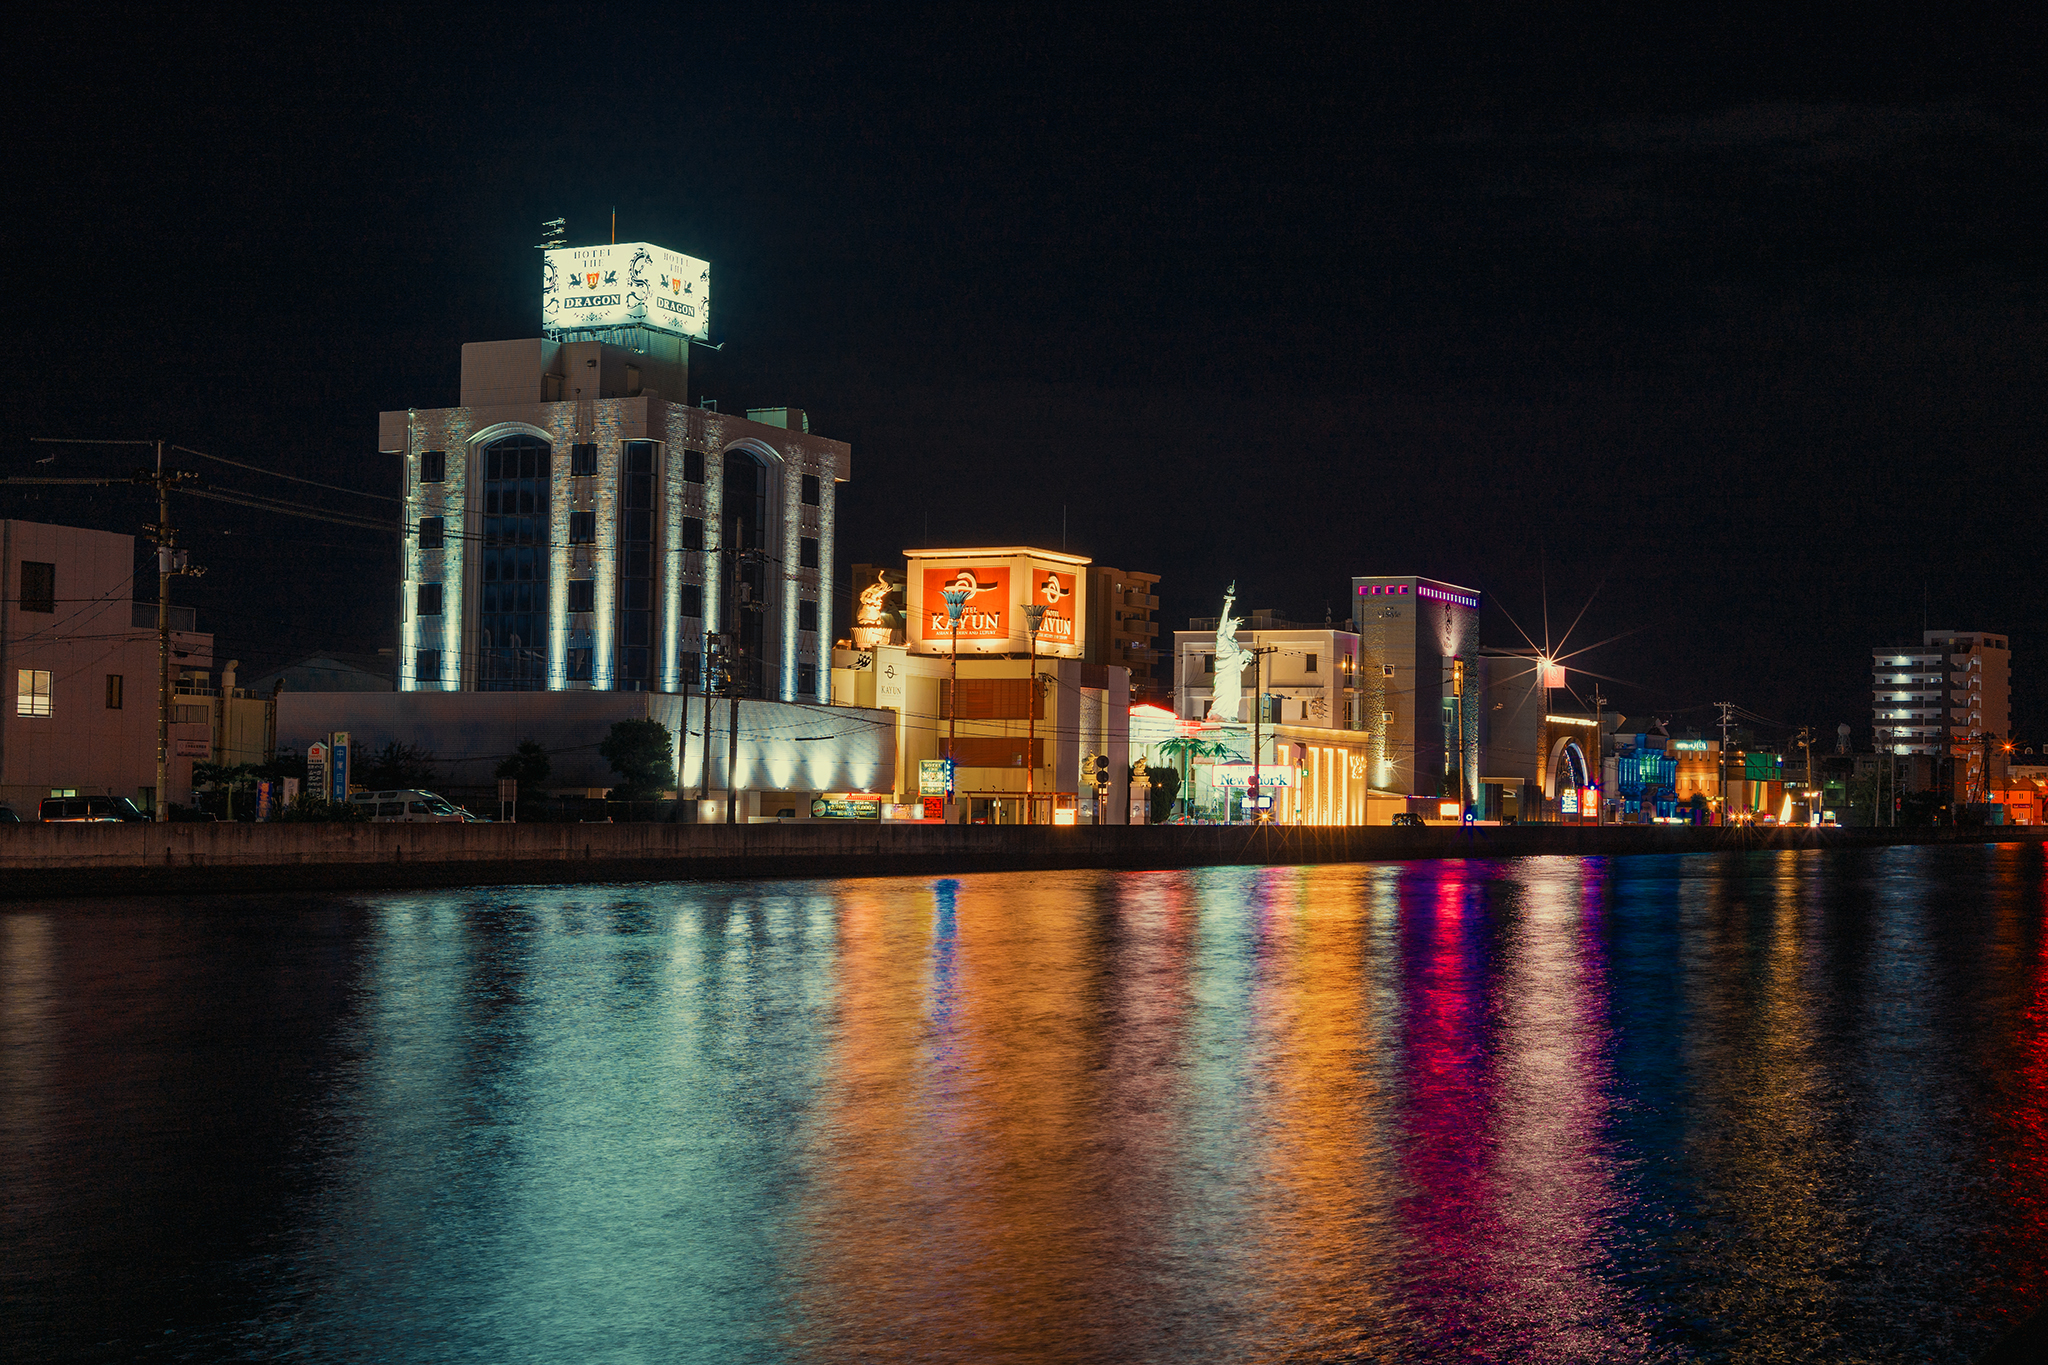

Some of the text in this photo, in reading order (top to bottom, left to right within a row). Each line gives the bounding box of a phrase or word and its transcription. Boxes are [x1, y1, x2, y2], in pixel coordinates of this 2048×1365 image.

[574, 249, 613, 259] HOTEL
[663, 252, 690, 267] HOTEL
[582, 259, 604, 268] THE
[565, 294, 620, 308] DRAGON
[657, 297, 694, 316] DRAGON
[1039, 617, 1071, 635] AYUN
[881, 685, 902, 695] KAYUN
[1219, 773, 1245, 786] New
